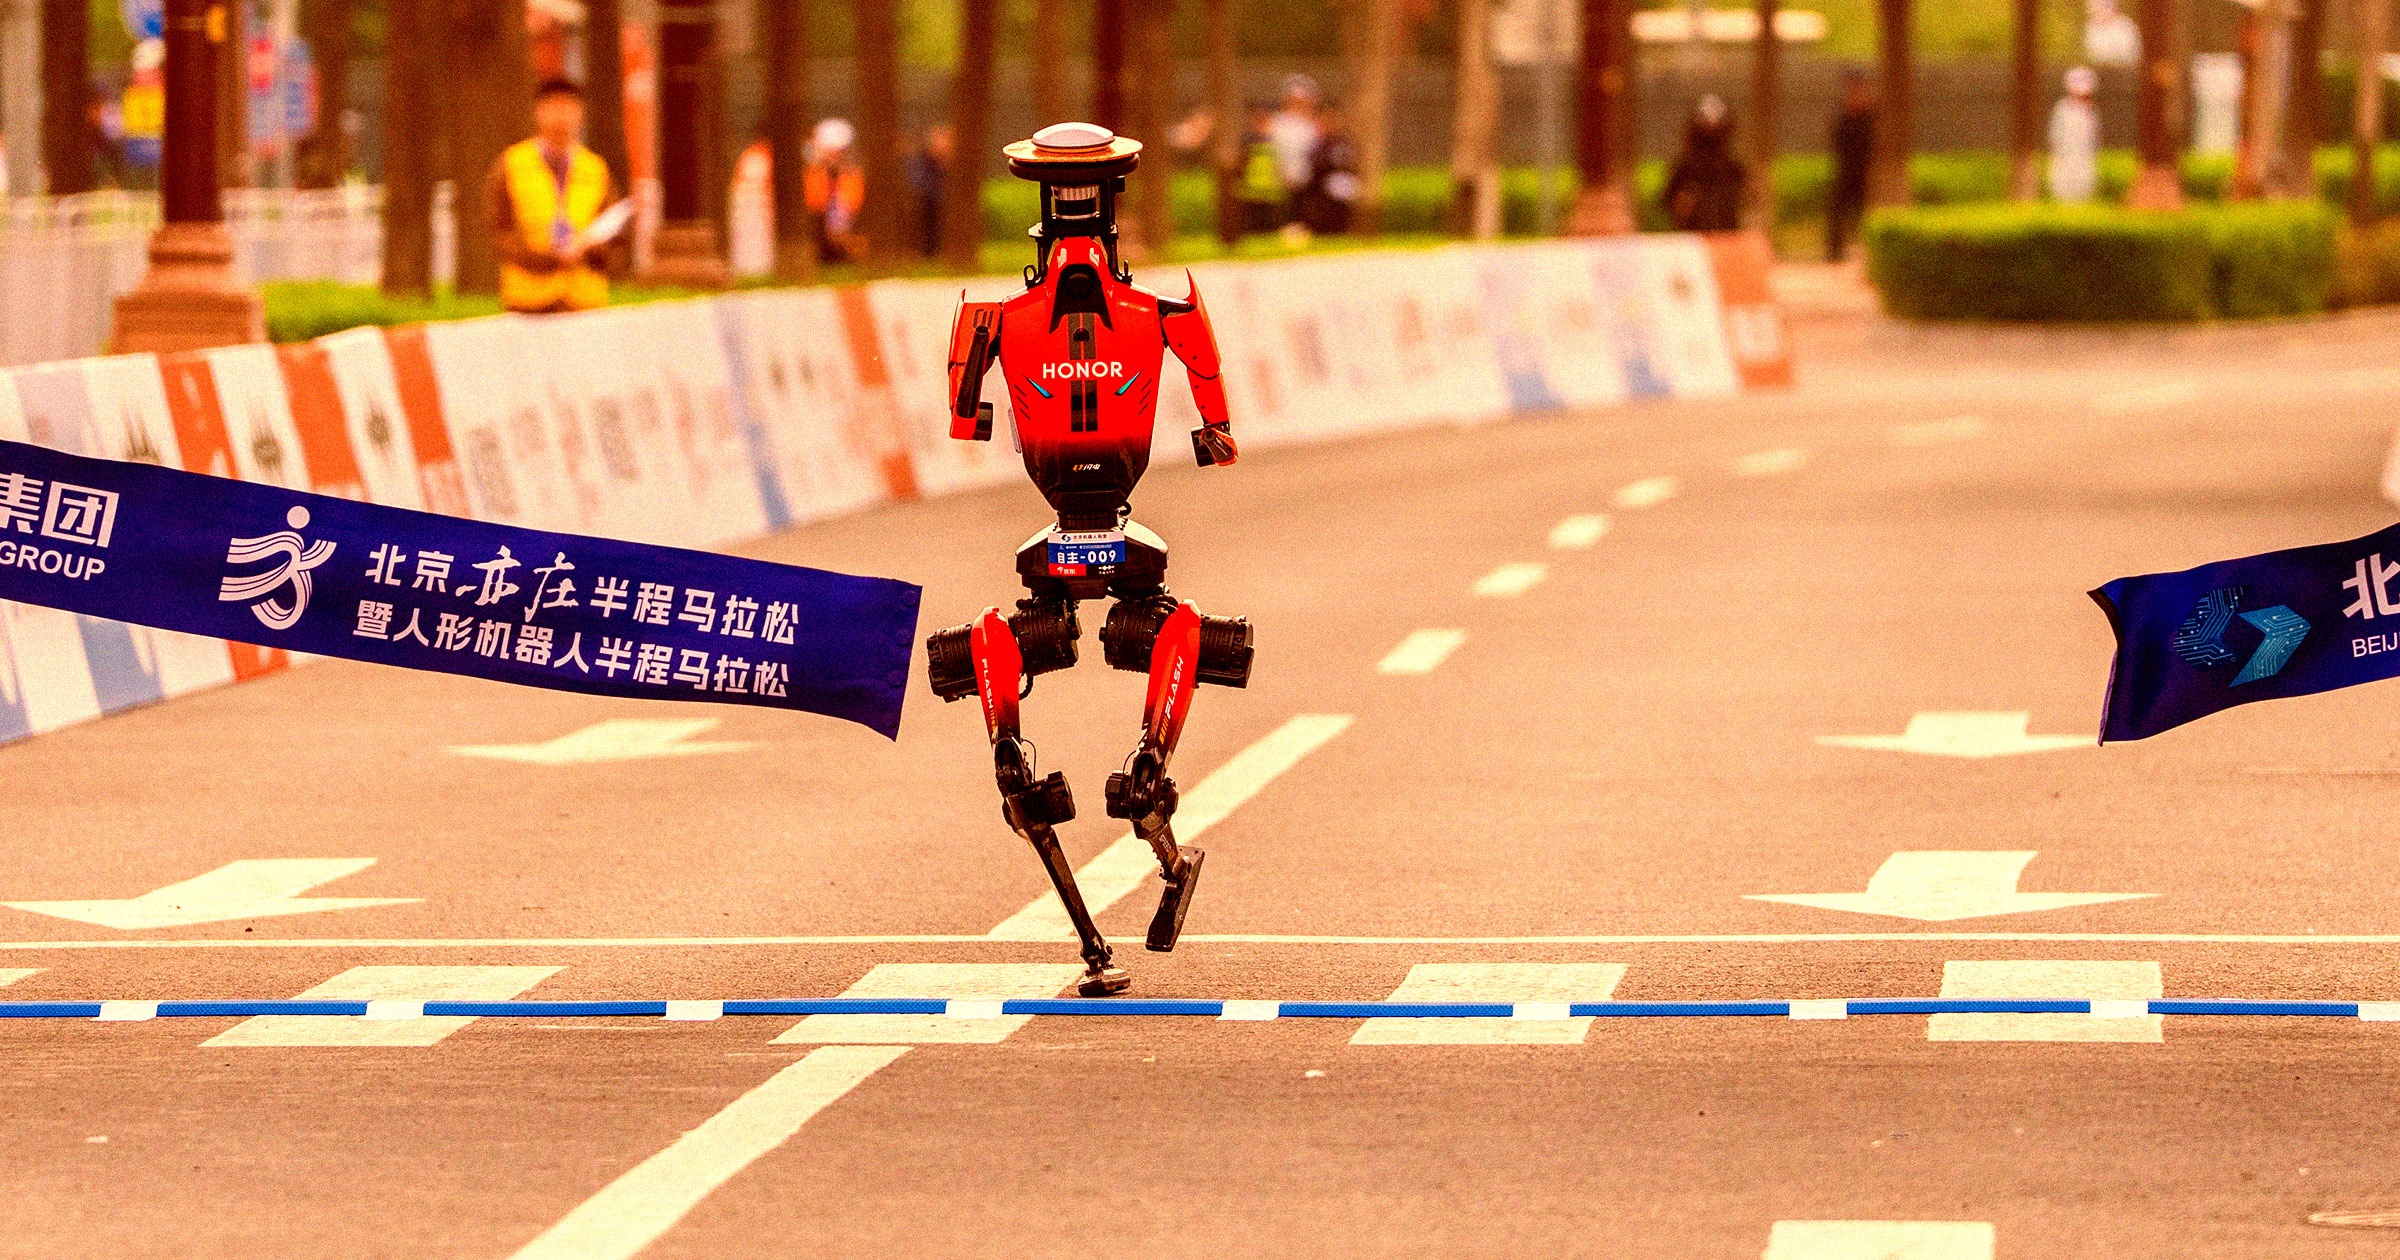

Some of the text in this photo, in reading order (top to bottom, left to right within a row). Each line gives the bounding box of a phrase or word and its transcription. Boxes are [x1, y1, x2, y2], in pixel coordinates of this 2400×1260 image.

[1043, 361, 1123, 379] HONOR
[0, 540, 106, 581] GROUP
[1057, 549, 1116, 564] 自主-009
[364, 543, 799, 645] 北京亦庄半程马拉松
[2342, 552, 2400, 620] 北
[352, 599, 790, 698] 暨人形机器人半程马拉松
[2352, 632, 2400, 658] BEIJ
[981, 658, 994, 709] FLASH
[1164, 655, 1184, 720] FLASH
